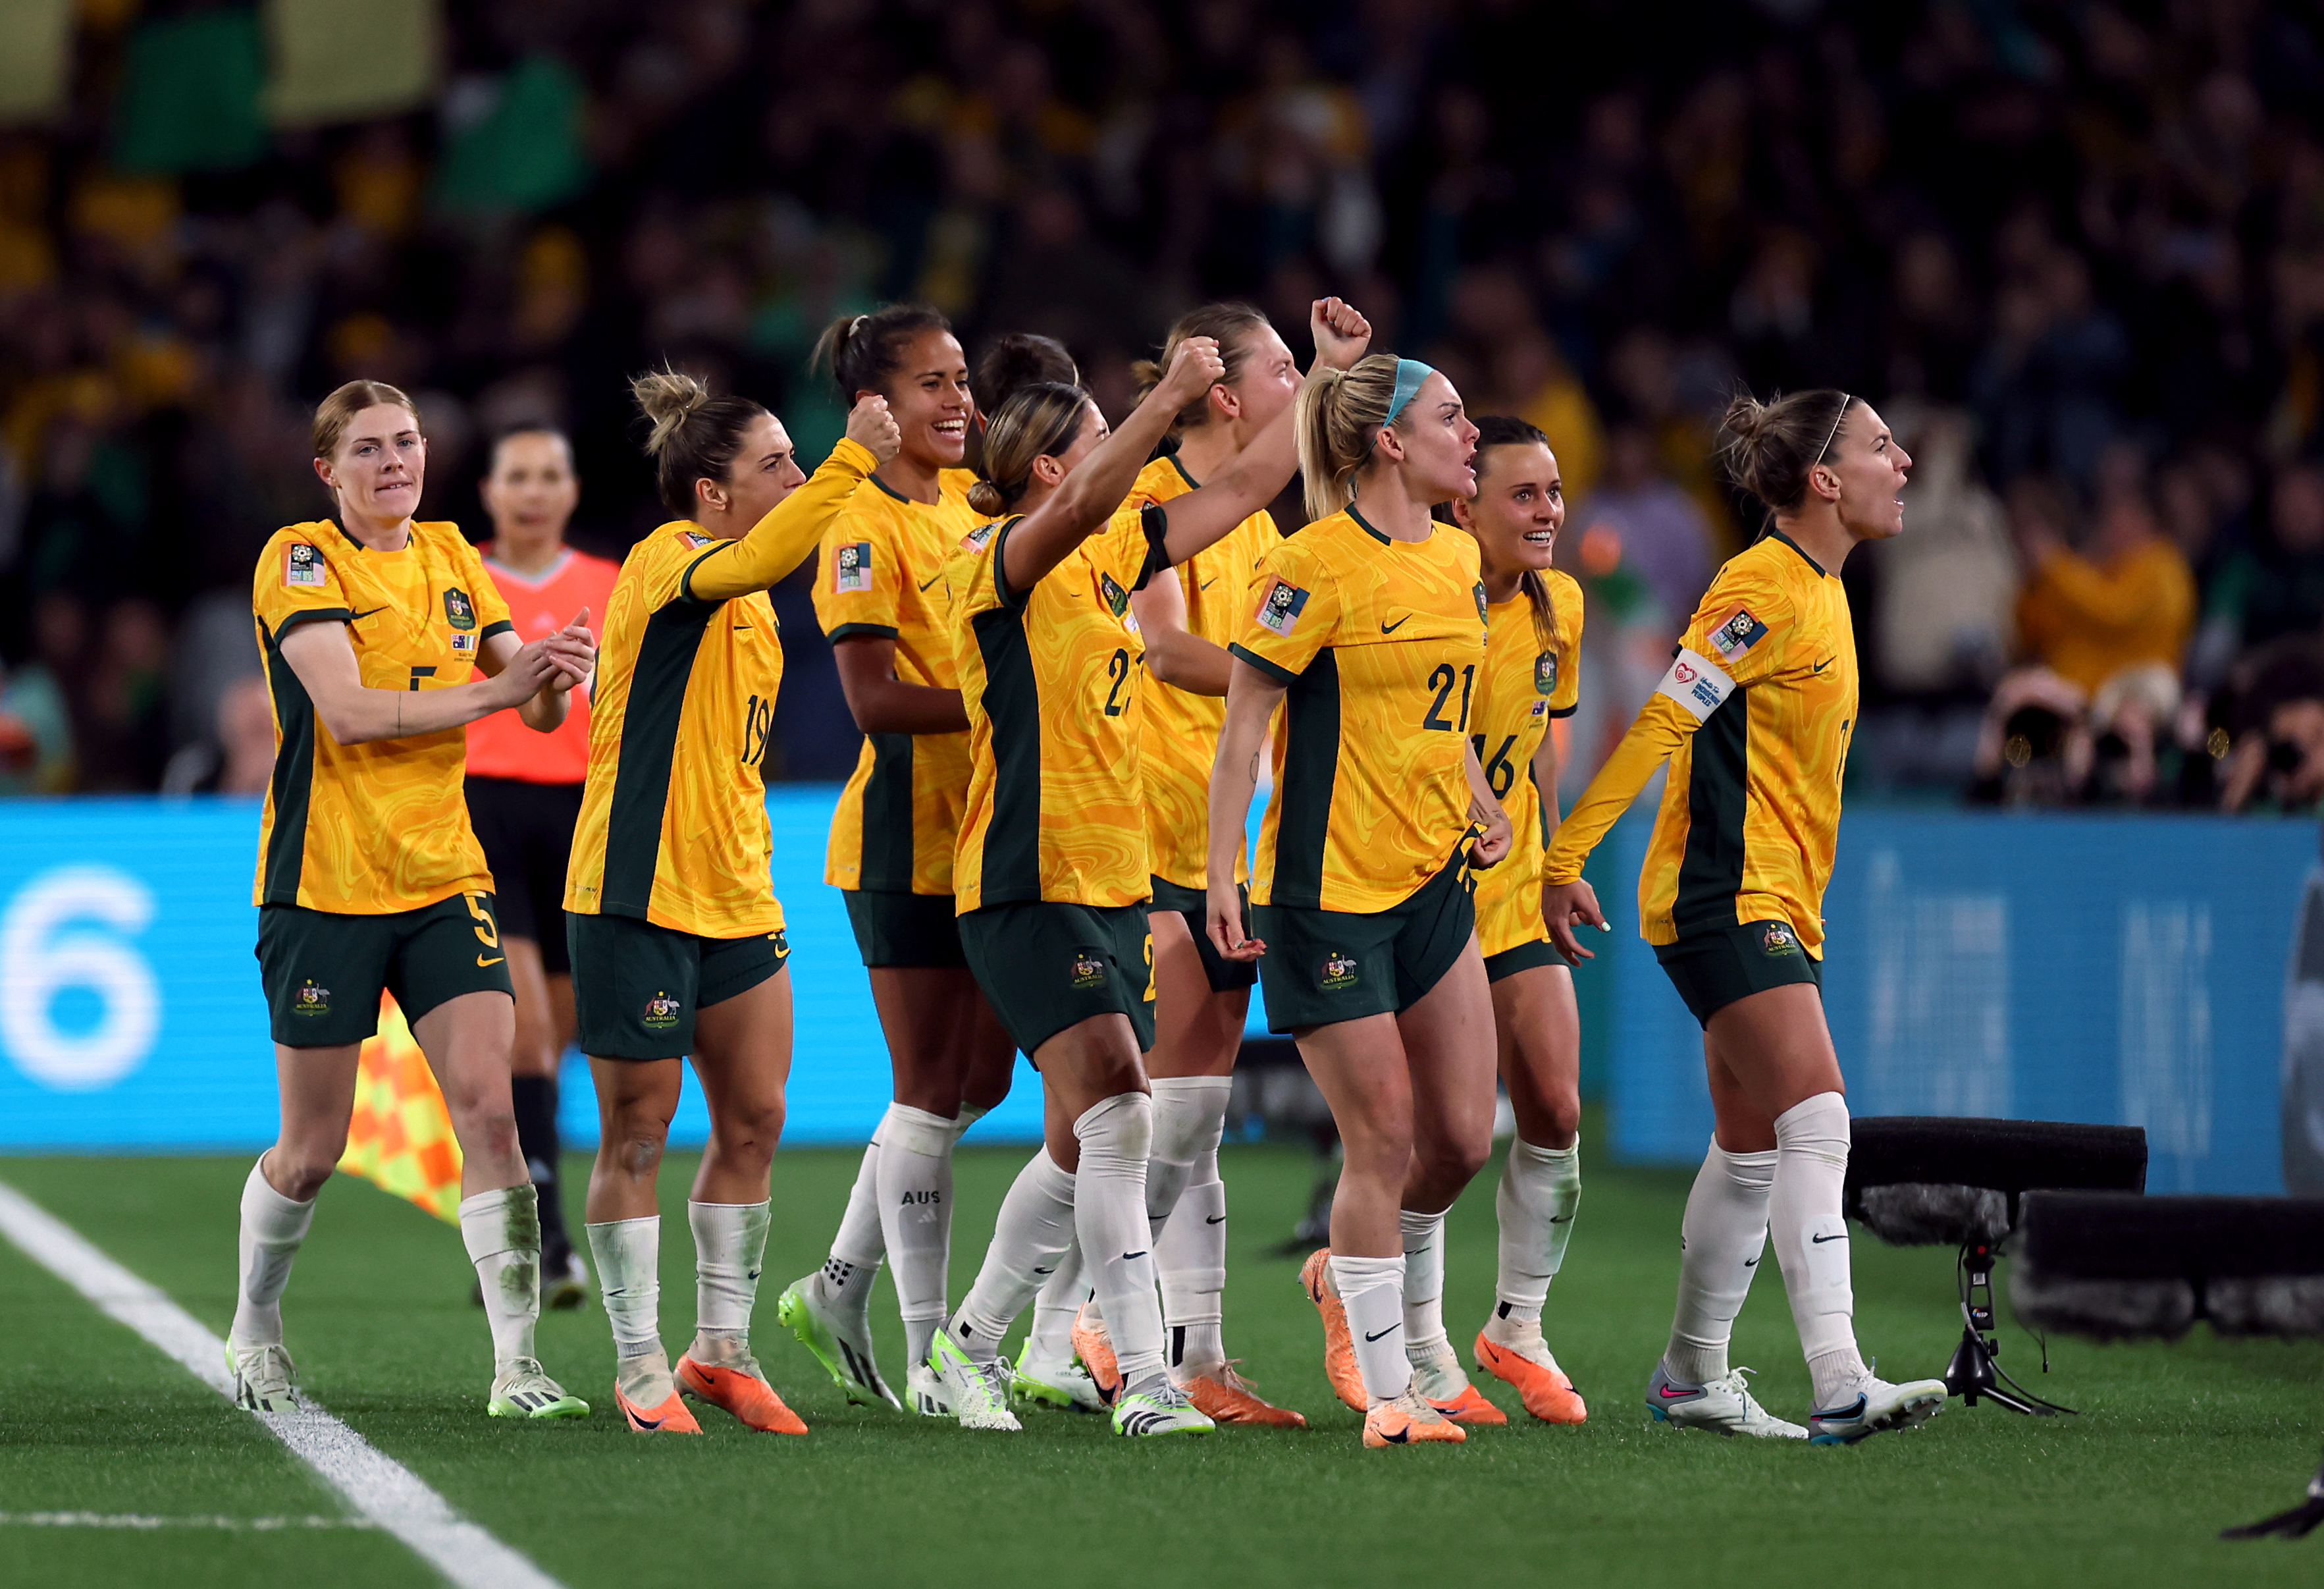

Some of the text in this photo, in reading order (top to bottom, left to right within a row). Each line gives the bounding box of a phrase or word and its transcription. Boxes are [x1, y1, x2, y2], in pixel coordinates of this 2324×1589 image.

[1105, 648, 1145, 716] 2
[1423, 663, 1475, 732] 21
[741, 693, 770, 766] 19
[463, 891, 498, 948] 5
[0, 861, 159, 1092] 6
[1323, 974, 1355, 984] AUSTRALIA
[901, 1190, 941, 1205] AUS
